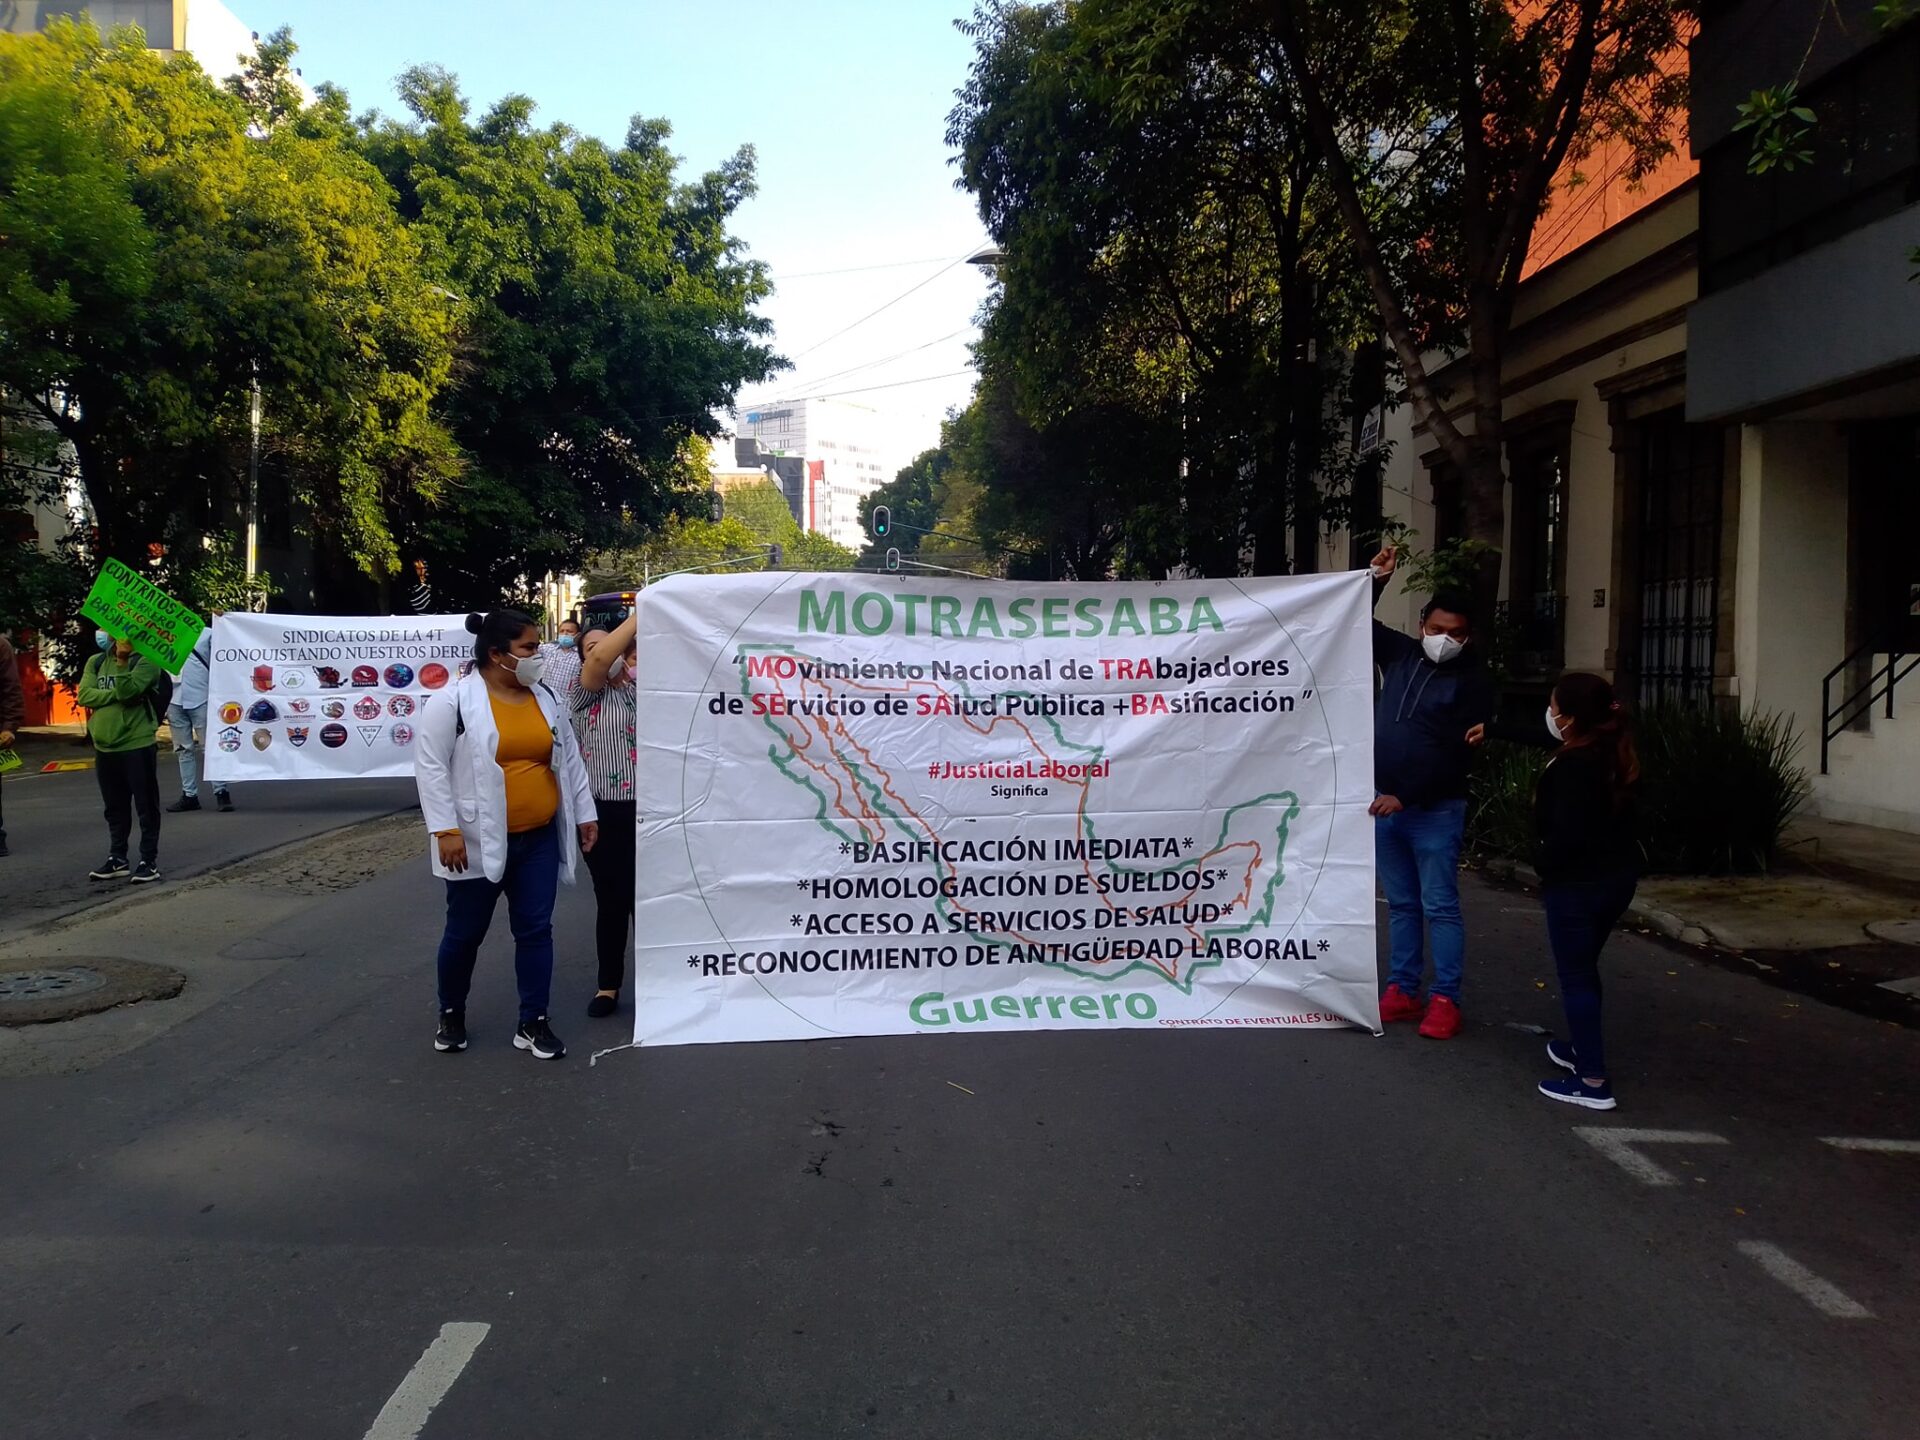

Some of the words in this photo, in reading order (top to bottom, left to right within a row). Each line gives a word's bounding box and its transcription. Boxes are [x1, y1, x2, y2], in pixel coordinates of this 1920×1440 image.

[106, 562, 177, 615] CONTRATOS
[116, 588, 176, 630] GUERRERO
[117, 601, 177, 643] EXIGIMOS
[798, 589, 1224, 638] MOTRASESABA
[282, 630, 376, 644] SINDICATOS
[380, 630, 400, 642] DE
[402, 630, 422, 642] LA
[426, 629, 445, 641] 4T
[215, 647, 342, 662] CONQUISTANDO
[345, 646, 426, 660] NUESTROS
[932, 660, 1050, 681] Nacional
[1060, 659, 1094, 681] de
[1099, 655, 1289, 684] TRAbajadores
[709, 692, 743, 715] de
[751, 693, 866, 716] SErvicio
[874, 693, 908, 716] de
[916, 693, 997, 716] SAlud
[1006, 692, 1105, 716] Pública
[1113, 690, 1294, 716] +BAsificación
[928, 760, 1110, 780] #JusticiaLaboral
[990, 784, 1049, 800] Significa
[1055, 875, 1090, 896] DE
[921, 913, 940, 935] A
[948, 909, 1087, 934] SERVICIOS
[1095, 908, 1128, 929] DE
[965, 944, 1000, 966] DE
[1007, 937, 1183, 965] ANTIGÜEDAD
[909, 991, 1158, 1027] Guerrero
[1158, 1018, 1223, 1027] CONTRATO
[1225, 1018, 1241, 1026] DE
[1243, 1013, 1321, 1025] EVENTUALES
